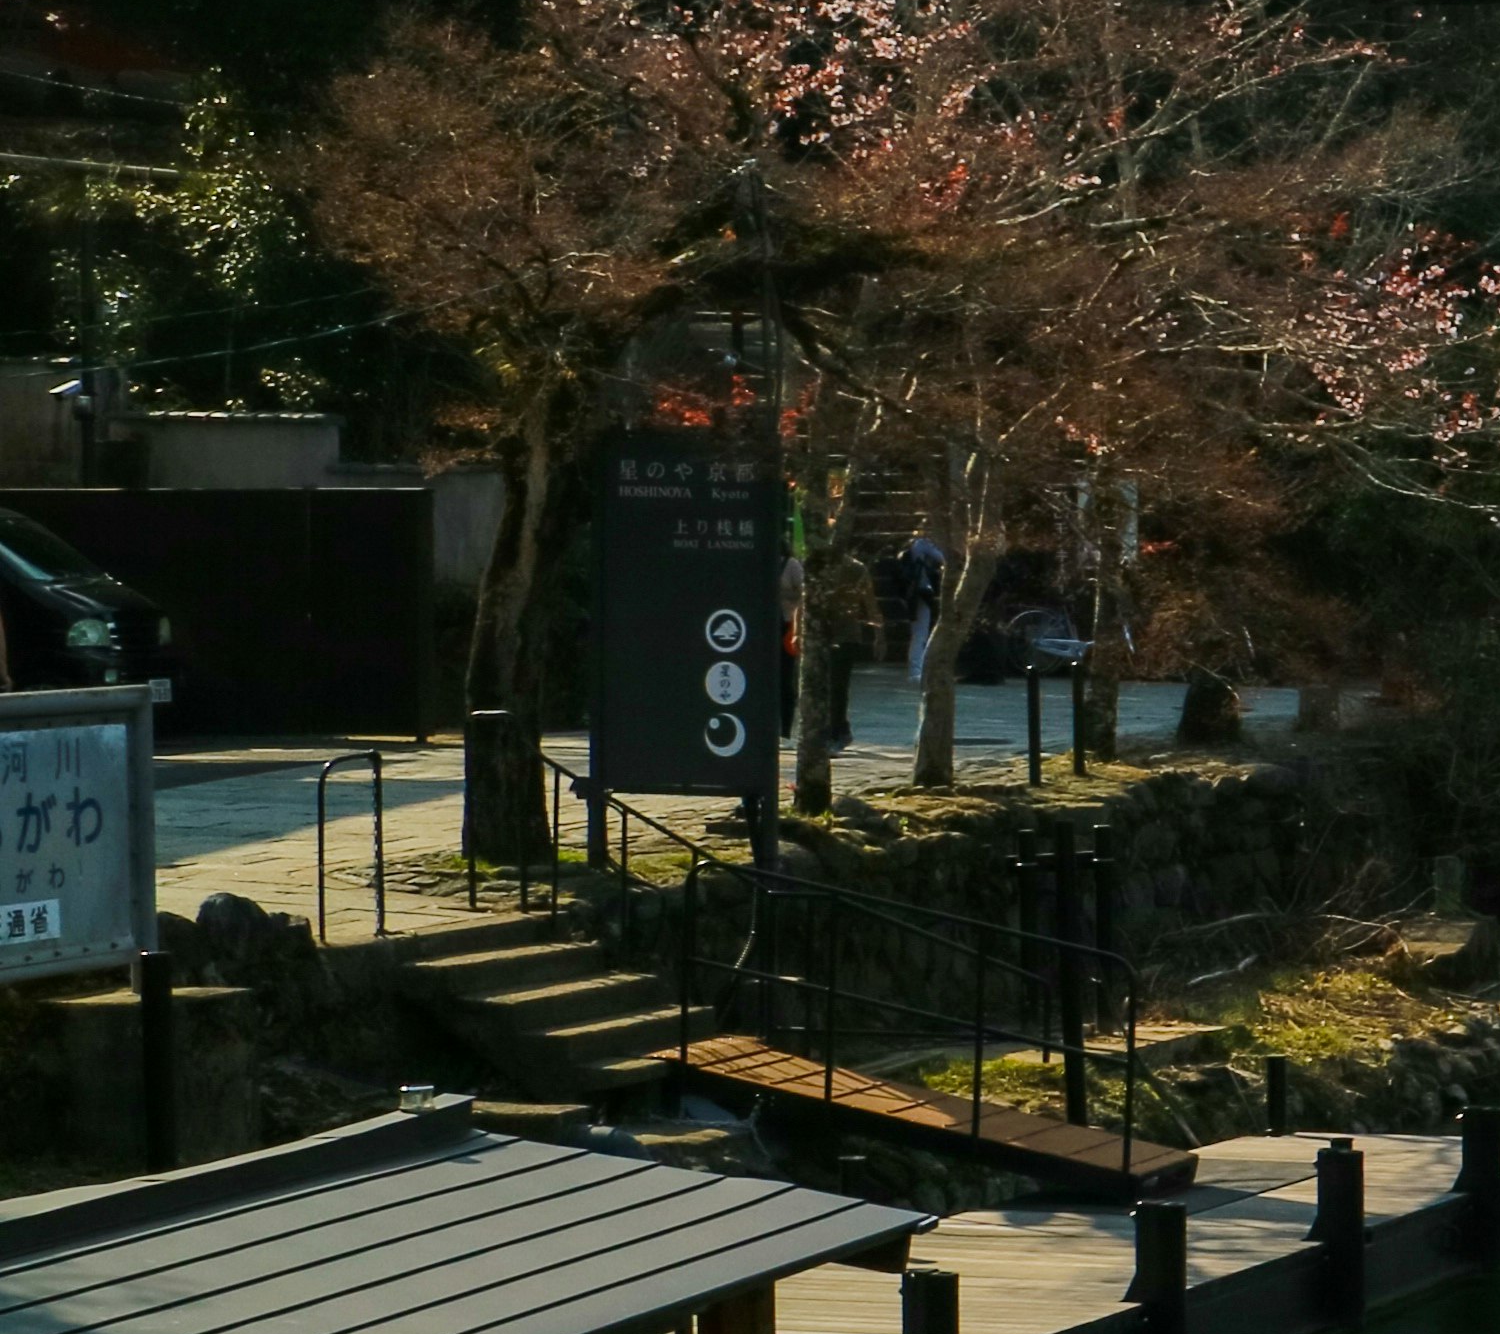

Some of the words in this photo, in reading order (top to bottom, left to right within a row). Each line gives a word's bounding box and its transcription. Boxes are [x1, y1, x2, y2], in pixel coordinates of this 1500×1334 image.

[620, 460, 693, 481] 星のや
[619, 486, 692, 498] HOSHINOYA
[711, 488, 749, 501] Kyoto
[719, 664, 731, 701] 星のや
[0, 786, 103, 853] がわ
[0, 905, 49, 940] 通省
